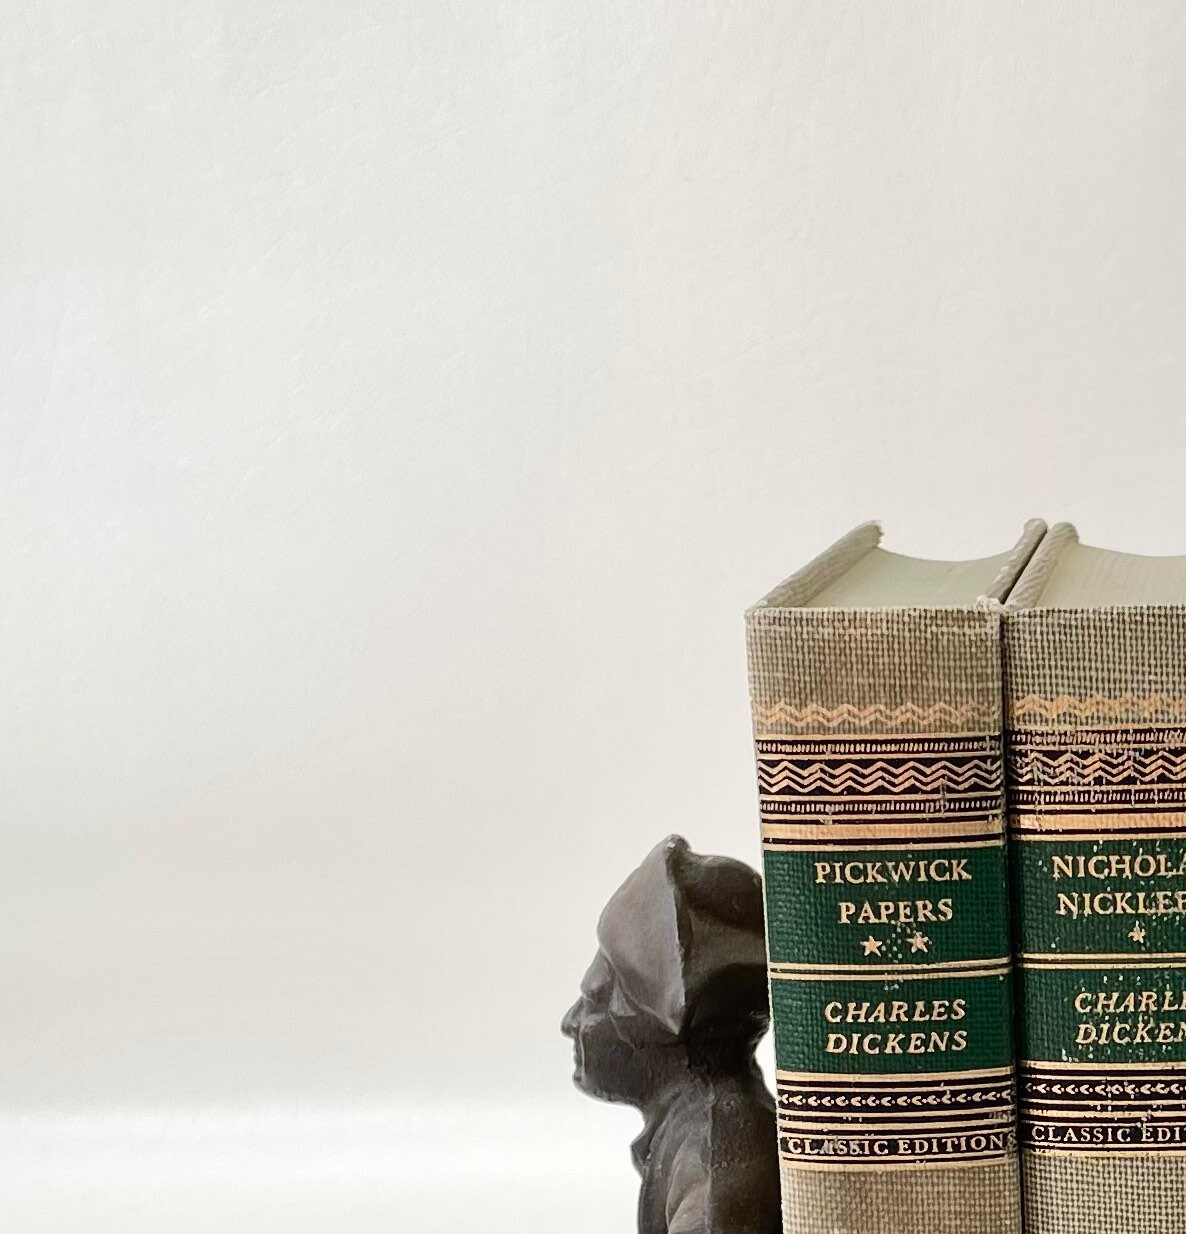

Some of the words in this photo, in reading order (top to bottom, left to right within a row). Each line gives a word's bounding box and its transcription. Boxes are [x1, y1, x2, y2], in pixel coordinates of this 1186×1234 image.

[813, 858, 972, 885] PICKWICK
[838, 899, 953, 924] PAPERS
[824, 999, 966, 1023] CHARLES
[825, 1030, 968, 1055] DICKENS
[1031, 1124, 1131, 1142] CLASSIC
[787, 1137, 889, 1155] CLASSIC
